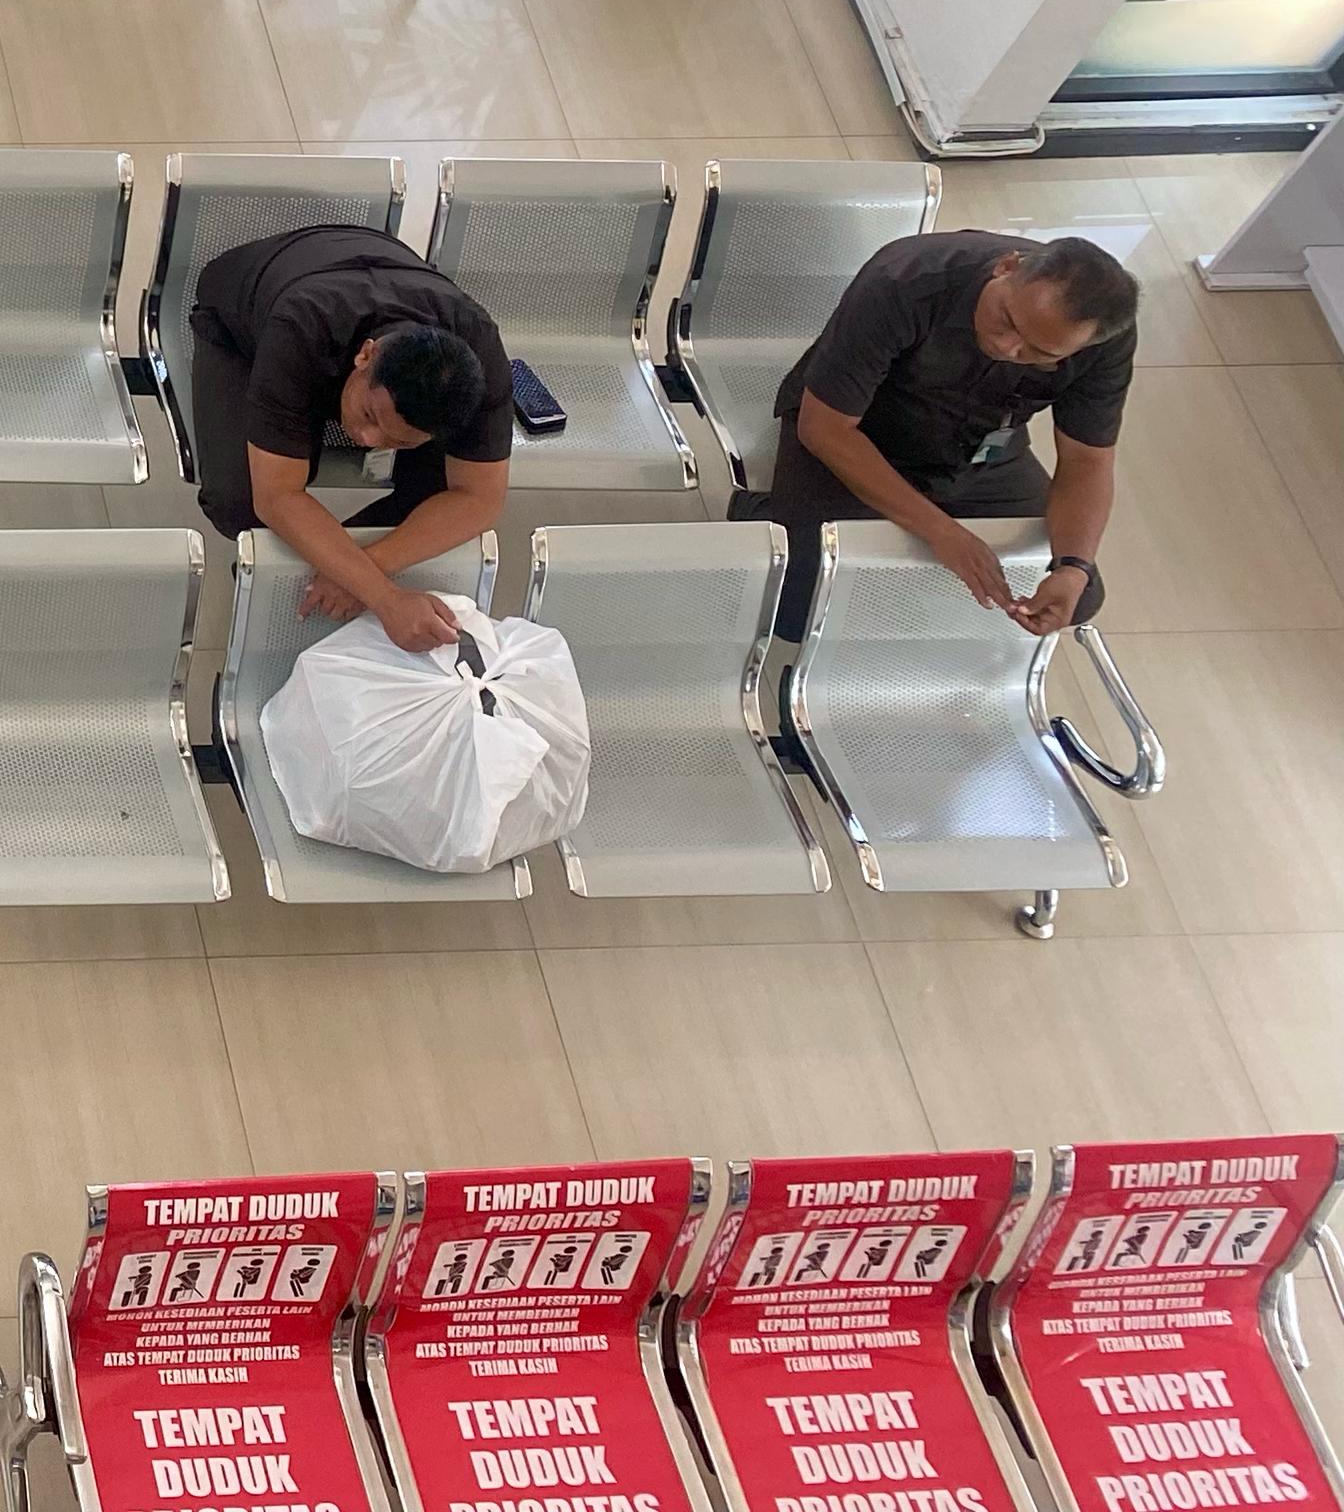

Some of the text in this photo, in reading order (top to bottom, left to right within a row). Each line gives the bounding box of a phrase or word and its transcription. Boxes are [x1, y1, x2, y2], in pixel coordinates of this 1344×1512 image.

[1108, 1155, 1299, 1189] TEMPAT DUDUK
[463, 1176, 656, 1213] TEMPAT DUDUK
[786, 1175, 979, 1208] TEMPAT DUDUK
[1124, 1186, 1263, 1209] PRIORITAS
[144, 1191, 340, 1226] TEMPAT DUDUK
[802, 1204, 941, 1227] PRIORITAS
[483, 1210, 622, 1233] PRIORITAS
[166, 1223, 305, 1246] PRIORITAS
[467, 1297, 536, 1311] KESEDIAAN
[537, 1296, 591, 1307] PESERTA
[849, 1287, 903, 1299] PESERTA
[155, 1308, 225, 1320] KESEDIAAN
[227, 1306, 281, 1317] PESERTA
[282, 1306, 313, 1314] LAIN
[452, 1308, 580, 1322] UNTUK MEMBERIKAN
[758, 1314, 890, 1332] KEPADA YANG BERHAK
[141, 1318, 271, 1332] UNTUK MEMBERIKAN
[446, 1321, 580, 1338] KEPADA YANG BERHAK
[1075, 1317, 1122, 1333] TEMPAT
[136, 1331, 271, 1348] KEPADA YANG BERHAK
[415, 1335, 609, 1359] ATAS TEMPAT DUDUK PRIORITAS
[730, 1331, 921, 1354] ATAS TEMPAT DUDUK PRIORITAS
[1096, 1336, 1145, 1353] TERIMA
[103, 1345, 300, 1367] ATAS TEMPAT DUDUK PRIORITAS
[468, 1357, 559, 1377] TERIMA KASIH
[784, 1354, 873, 1373] TERIMA KASIH
[158, 1367, 249, 1385] TERIMA KASIH
[1080, 1370, 1234, 1416] TEMPAT
[447, 1396, 601, 1439] TEMPAT
[765, 1390, 919, 1436] TEMPAT
[133, 1405, 287, 1448] TEMPAT
[1108, 1418, 1256, 1464] DUDUK
[469, 1445, 618, 1490] DUDUK
[790, 1440, 940, 1485] DUDUK
[151, 1454, 300, 1499] DUDUK
[1095, 1462, 1309, 1512] PRIORITAS
